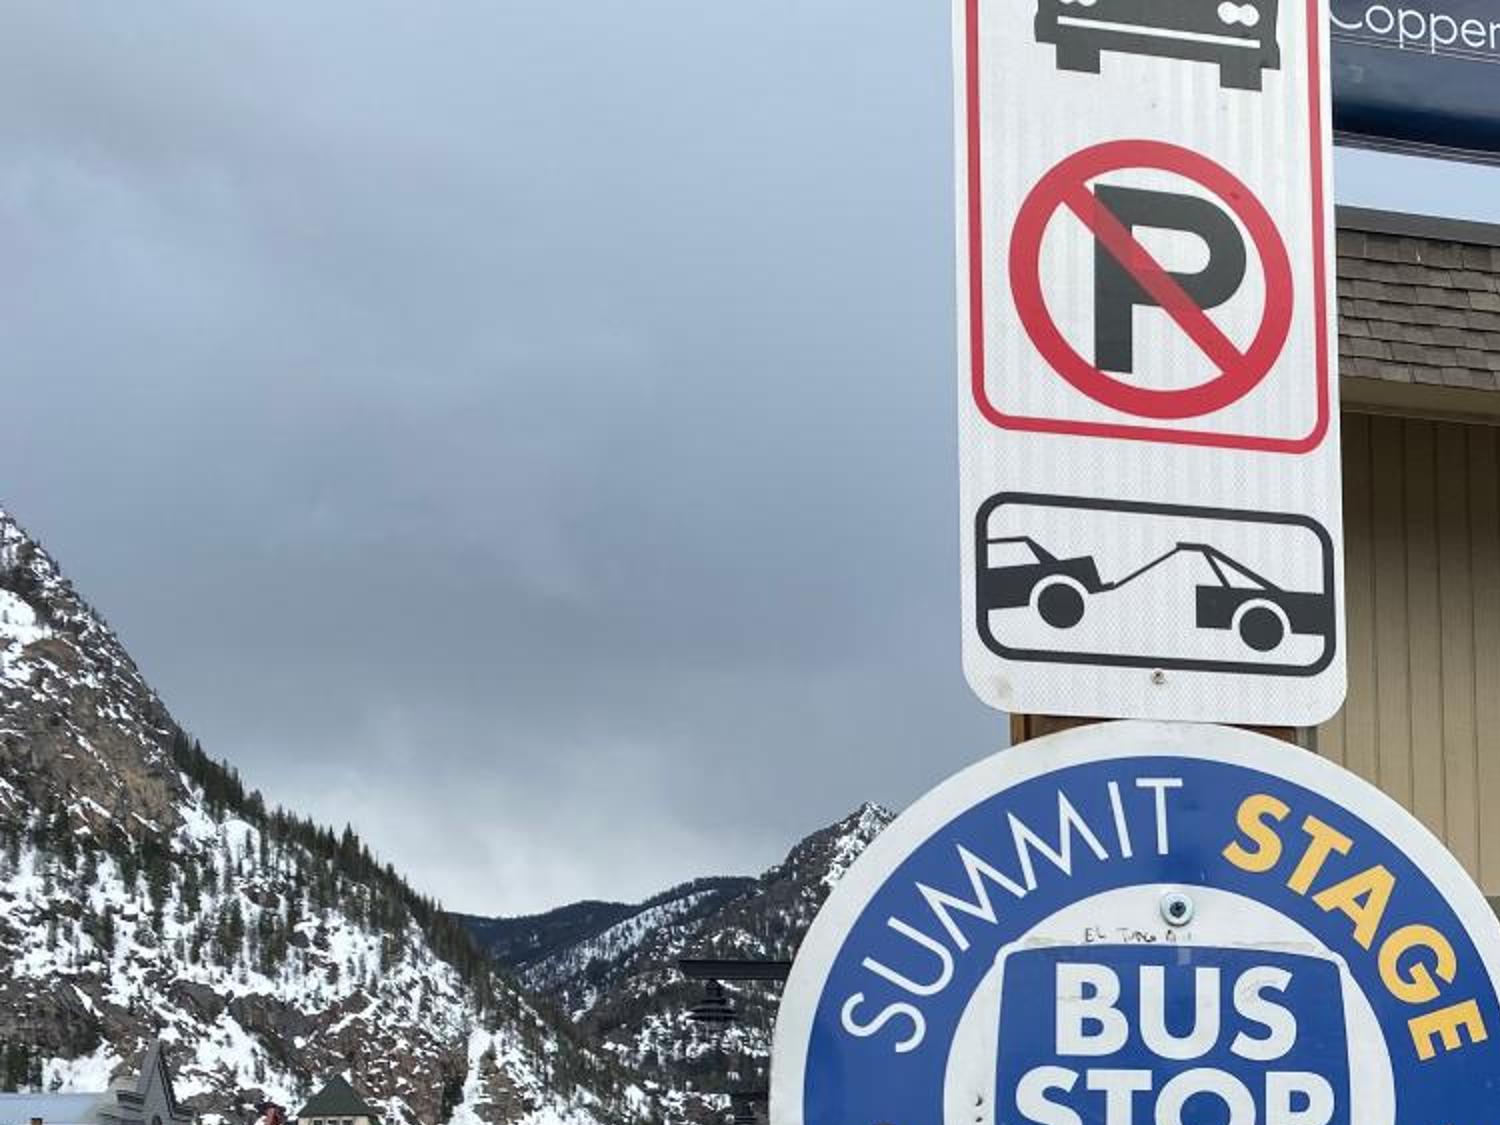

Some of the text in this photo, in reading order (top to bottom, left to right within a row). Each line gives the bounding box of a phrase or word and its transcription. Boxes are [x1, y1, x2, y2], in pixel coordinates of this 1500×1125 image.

[841, 777, 1489, 1061] SUMMIT STAGE
[1055, 962, 1297, 1061] BUS
